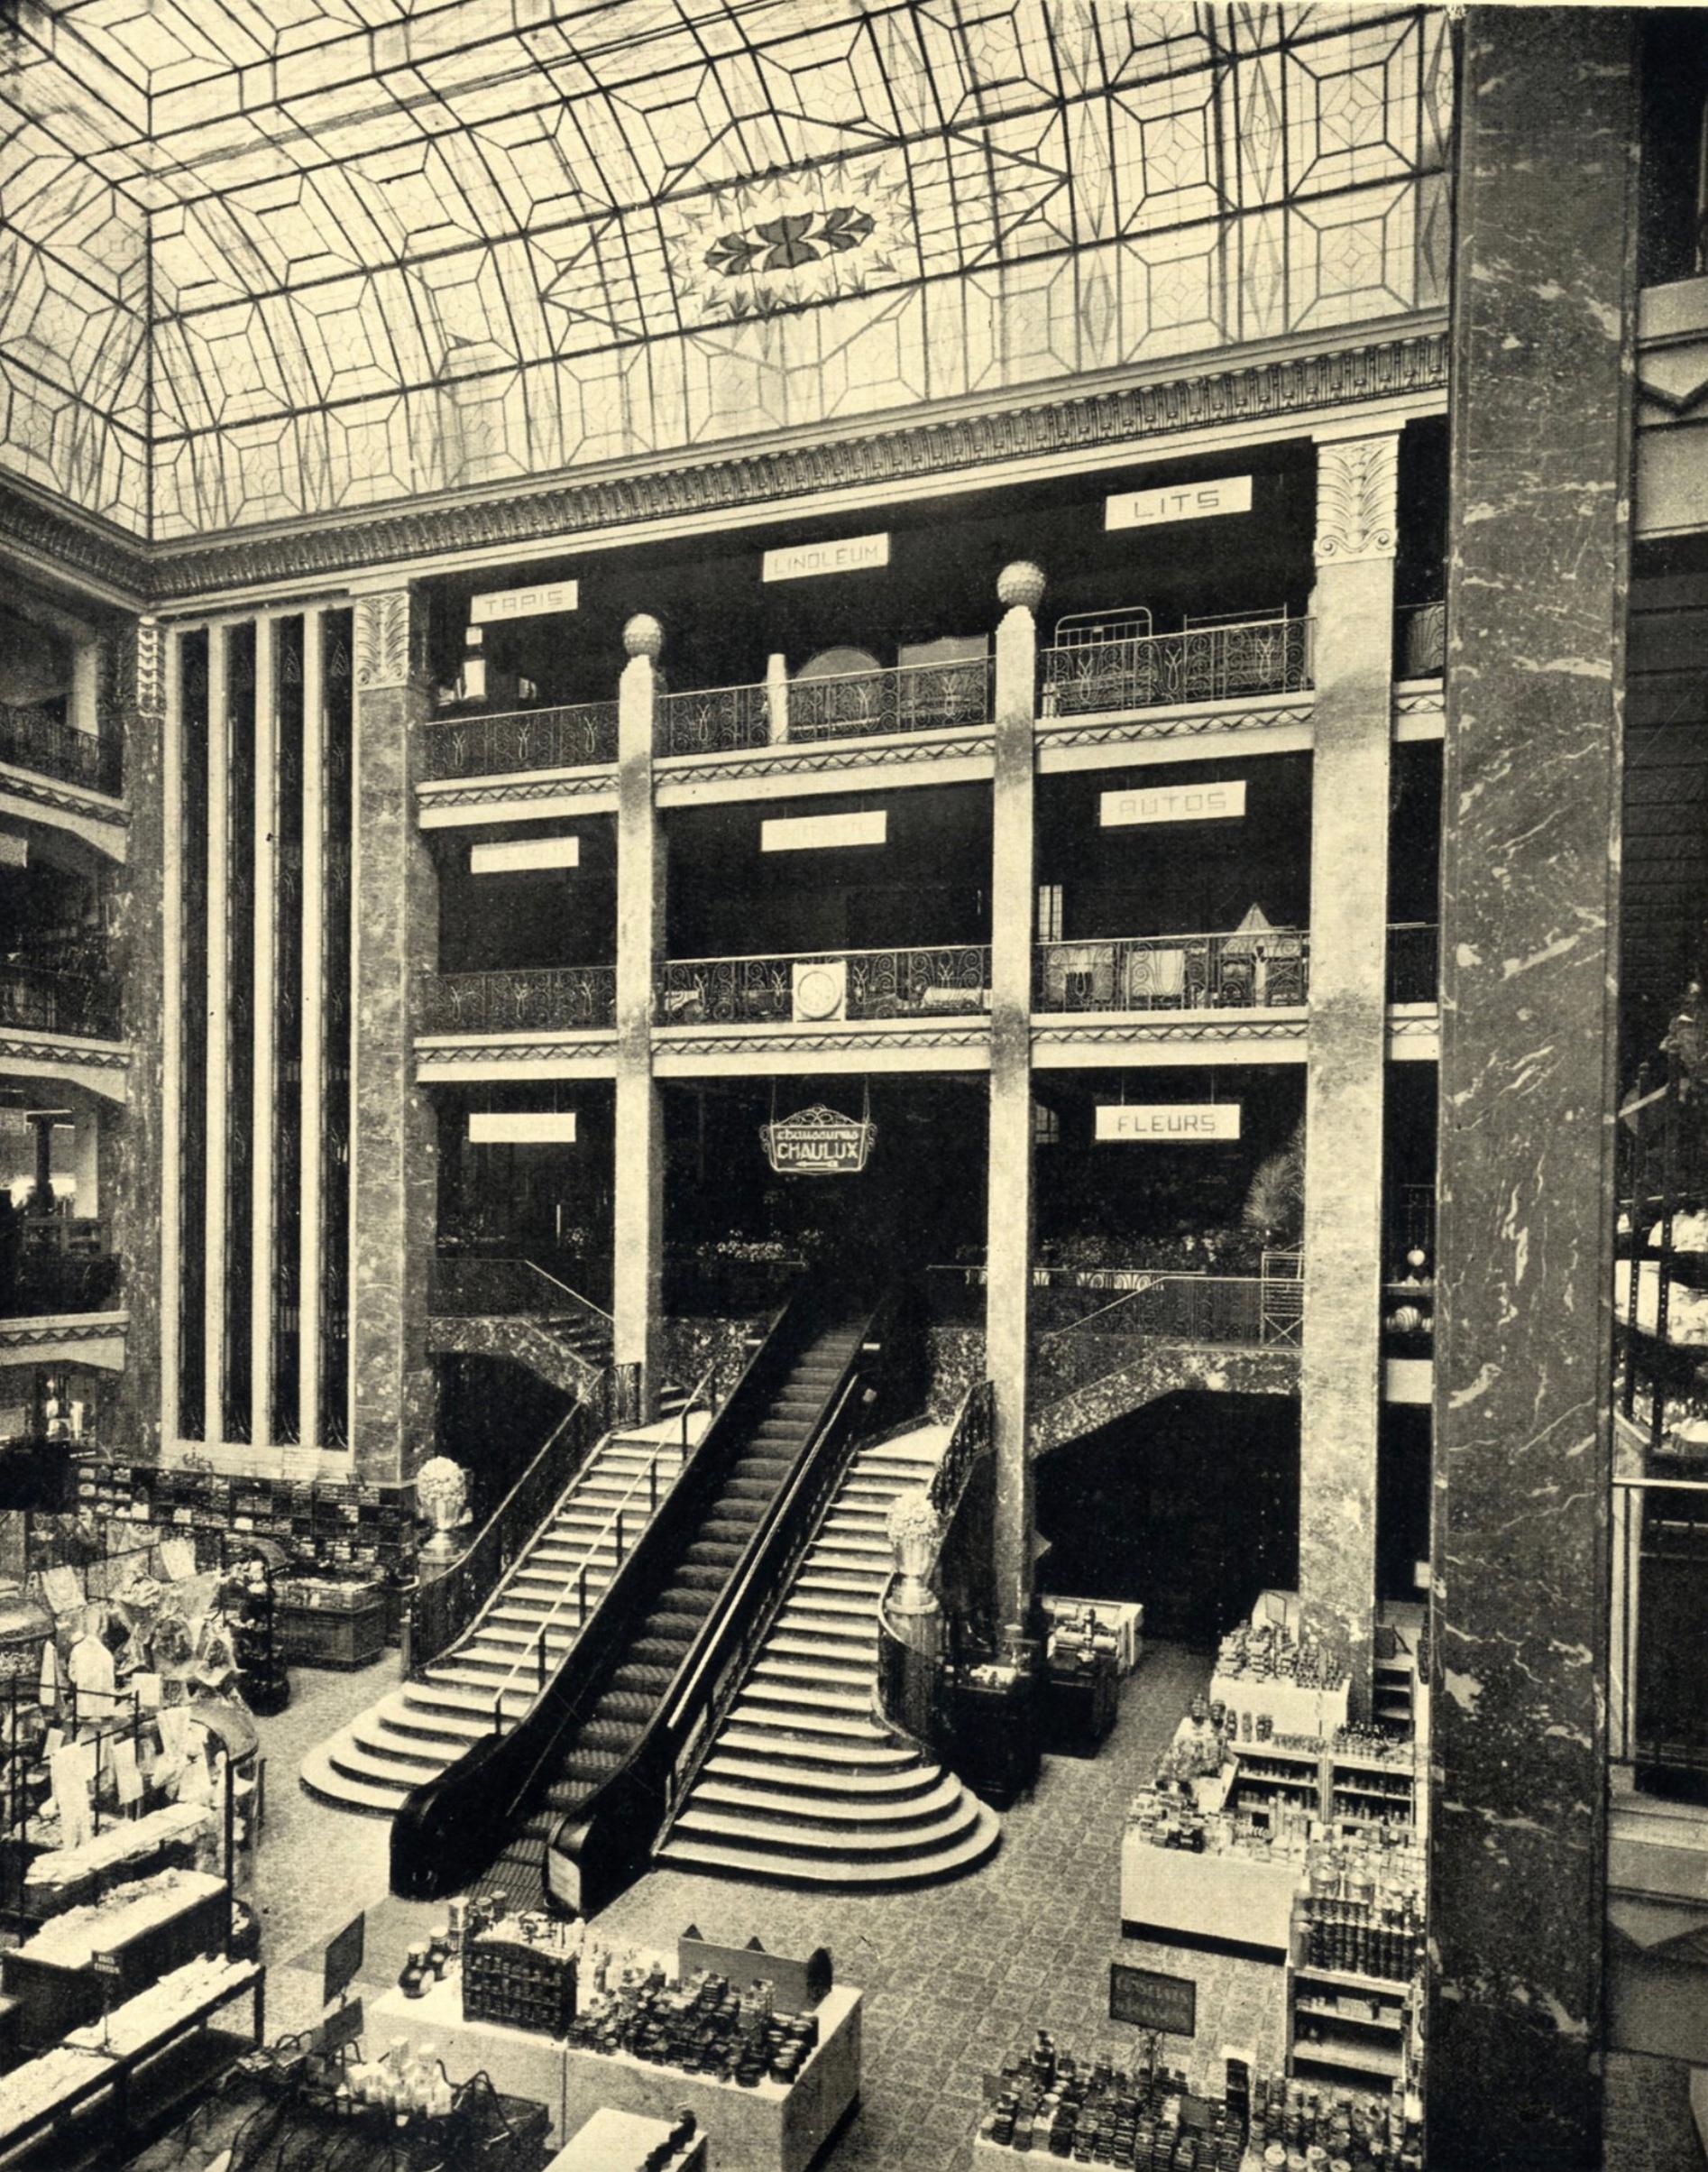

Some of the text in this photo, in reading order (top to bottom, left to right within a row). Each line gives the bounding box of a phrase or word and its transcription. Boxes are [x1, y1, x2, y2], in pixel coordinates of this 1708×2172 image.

[1134, 490, 1219, 518] LITS
[774, 546, 878, 574] LINOLEUM
[485, 590, 564, 615] TAPIS
[1120, 792, 1226, 815] AUTOS
[1118, 1114, 1217, 1133] FLEURS
[776, 1142, 859, 1160] CHAULUX
